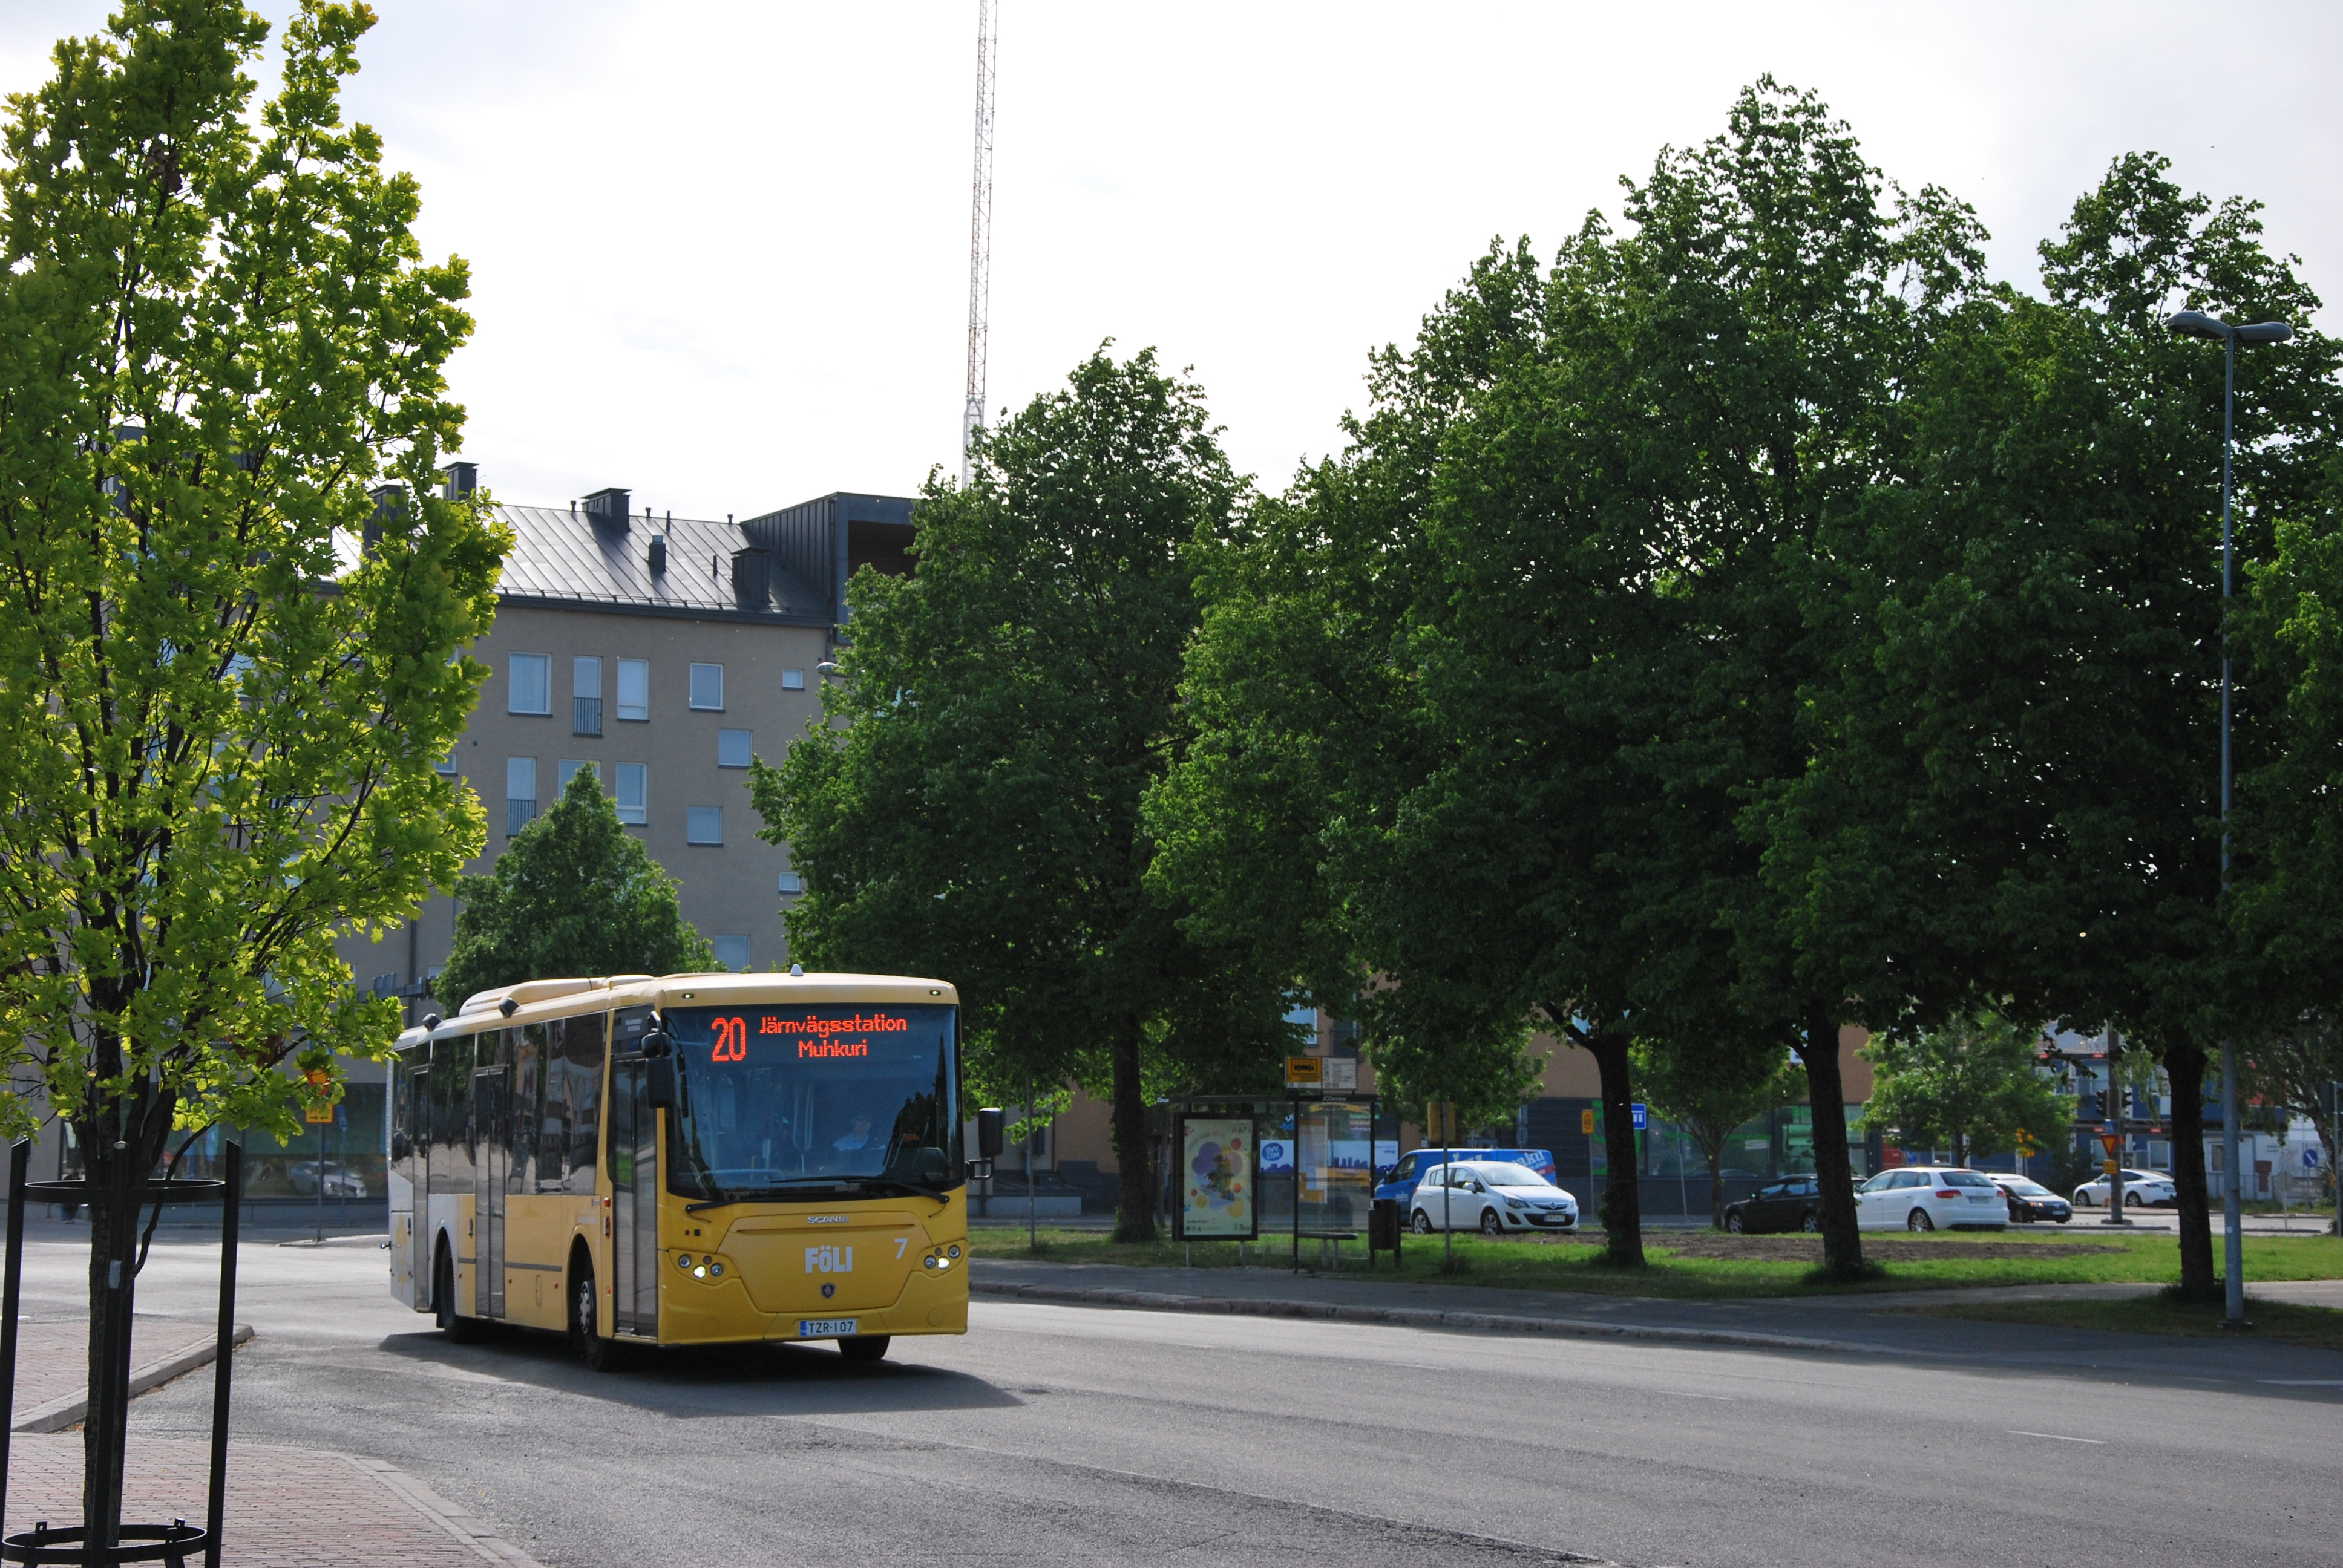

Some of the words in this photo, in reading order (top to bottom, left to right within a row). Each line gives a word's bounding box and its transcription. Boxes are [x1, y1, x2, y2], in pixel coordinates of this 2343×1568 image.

[759, 1014, 907, 1038] Järnvägsstation
[711, 1017, 747, 1062] 20
[798, 1039, 867, 1058] Muhkuri
[807, 1215, 850, 1224] SCANIA
[805, 1245, 853, 1273] FÖLI
[894, 1238, 908, 1259] 7
[808, 1321, 853, 1333] TZR-107
